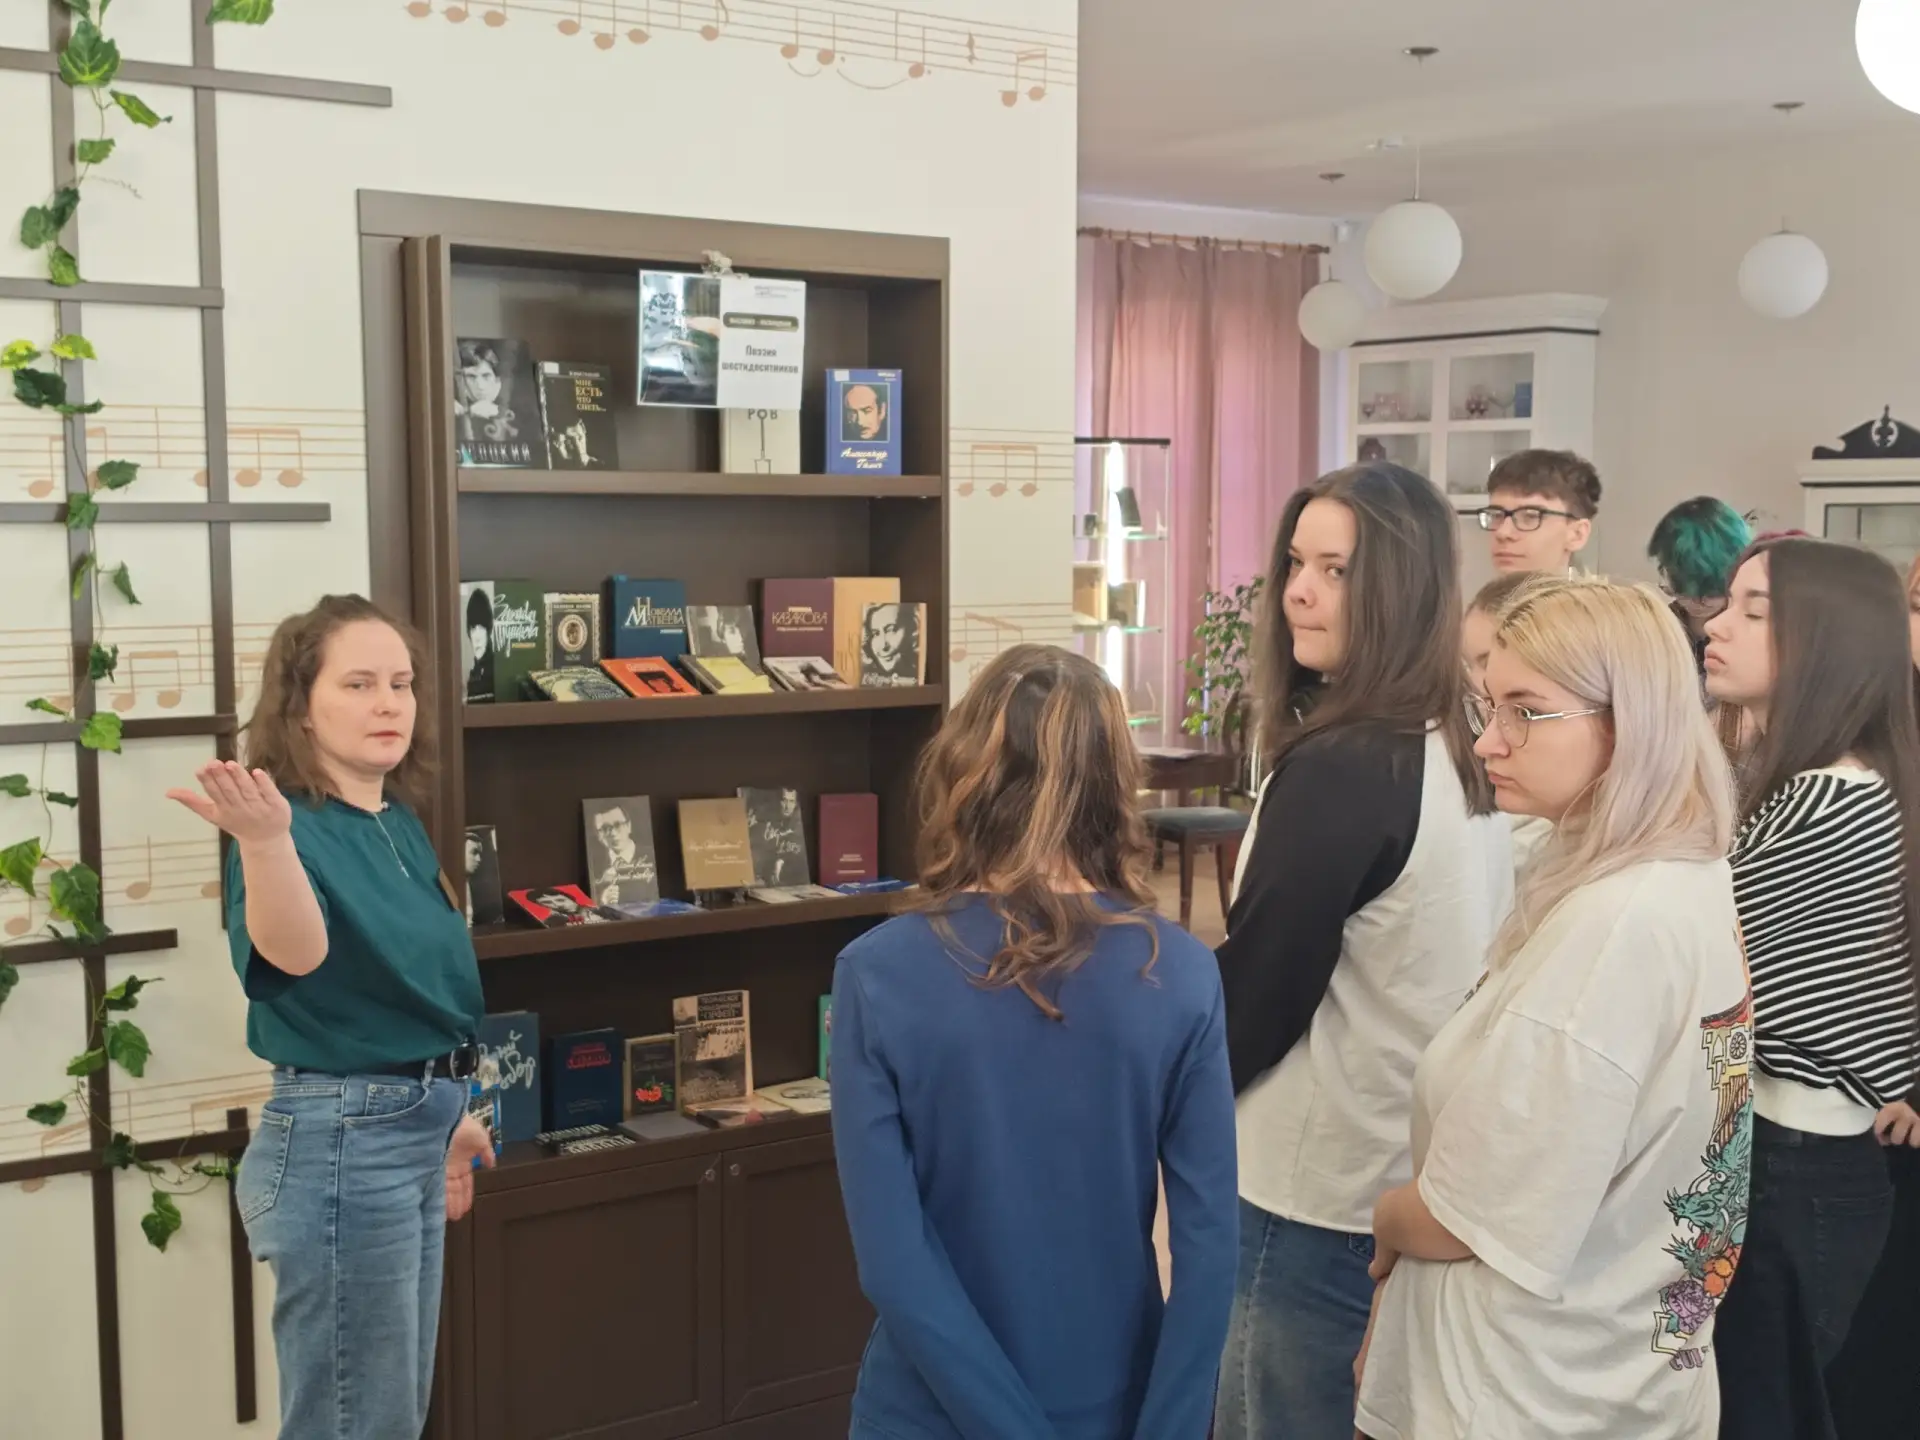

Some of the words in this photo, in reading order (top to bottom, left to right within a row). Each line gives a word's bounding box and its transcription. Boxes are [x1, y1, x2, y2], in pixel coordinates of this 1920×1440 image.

[745, 345, 777, 357] Поэзия
[721, 361, 799, 374] шестидесятников
[575, 387, 603, 397] ЕСТЬ
[771, 611, 828, 625] КАЗАКОВА
